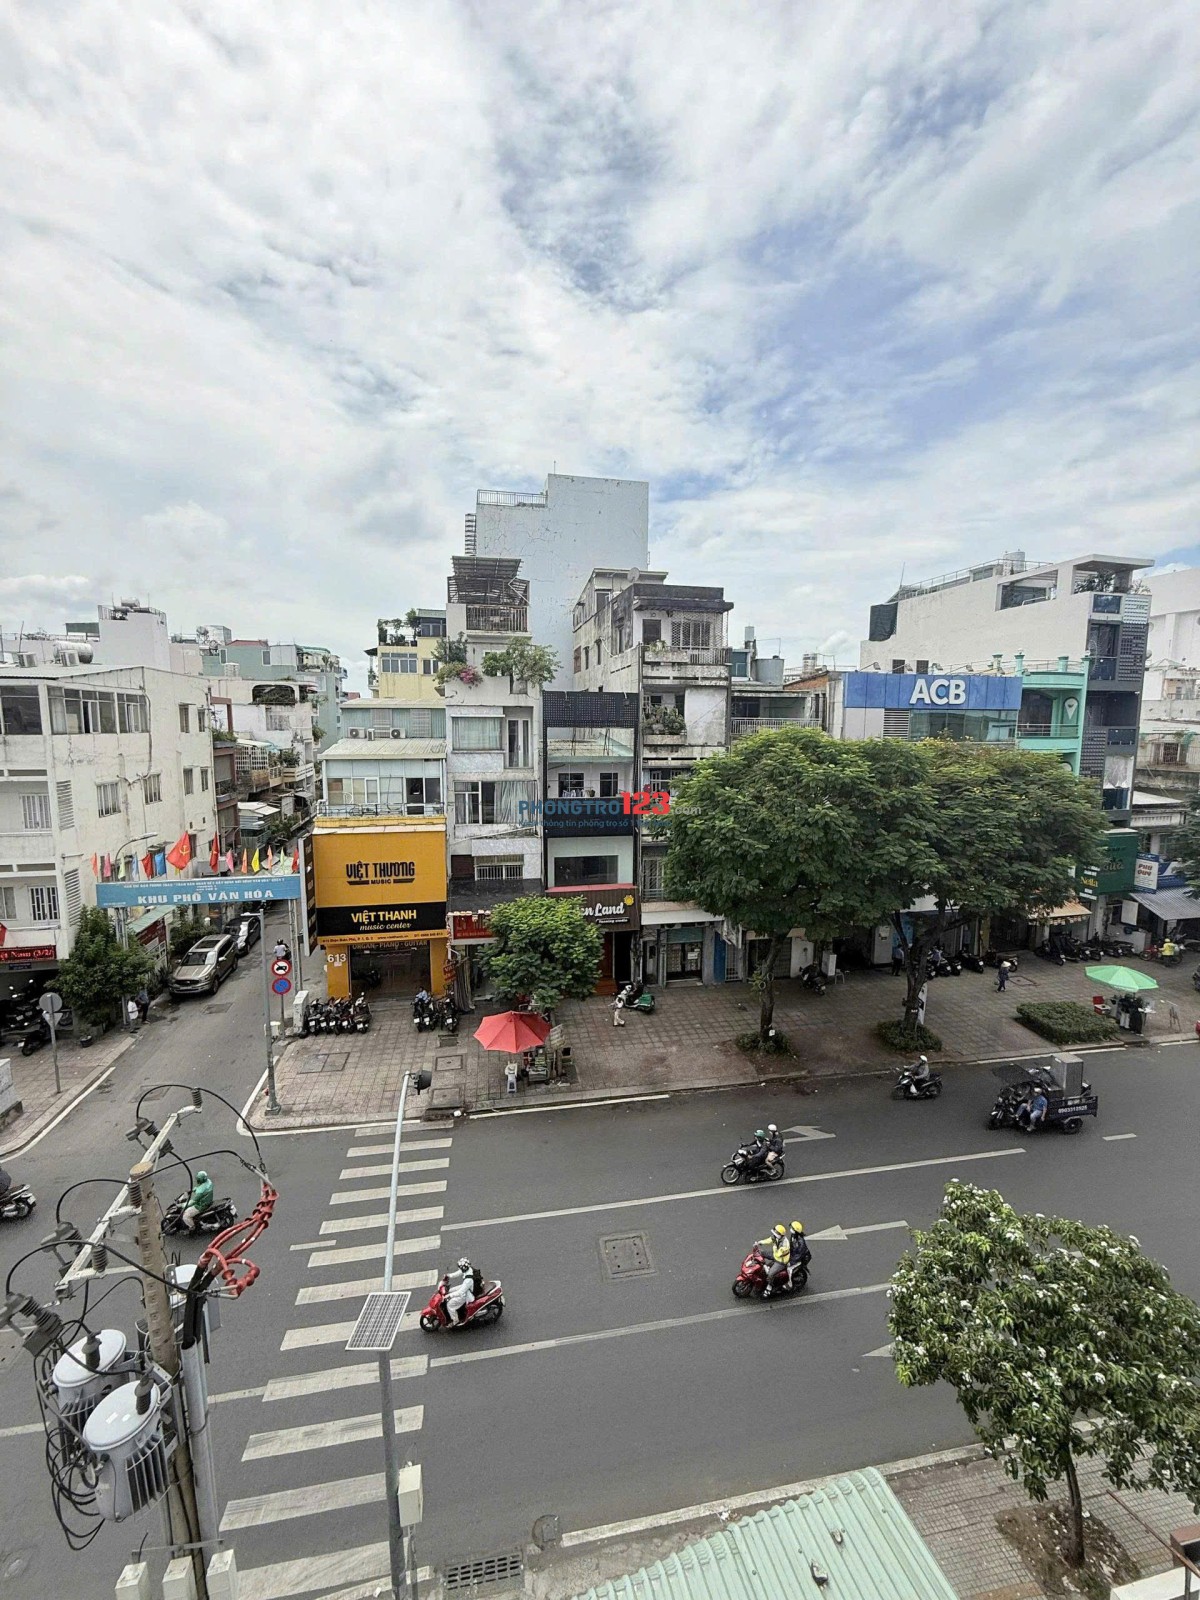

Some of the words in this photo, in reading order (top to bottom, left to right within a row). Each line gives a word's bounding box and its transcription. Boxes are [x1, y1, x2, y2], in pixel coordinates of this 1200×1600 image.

[909, 678, 966, 705] ACB
[346, 860, 370, 881] VIỆT
[138, 895, 168, 904] KHU
[173, 891, 202, 903] PHỐ
[208, 890, 239, 901] VĂN
[244, 889, 274, 899] HÓA
[594, 901, 625, 917] Land
[351, 911, 377, 924] VIỆT
[377, 910, 417, 921] THANH
[359, 923, 385, 931] music
[386, 922, 412, 930] center
[380, 941, 399, 949] PIANO
[327, 953, 347, 963] 613
